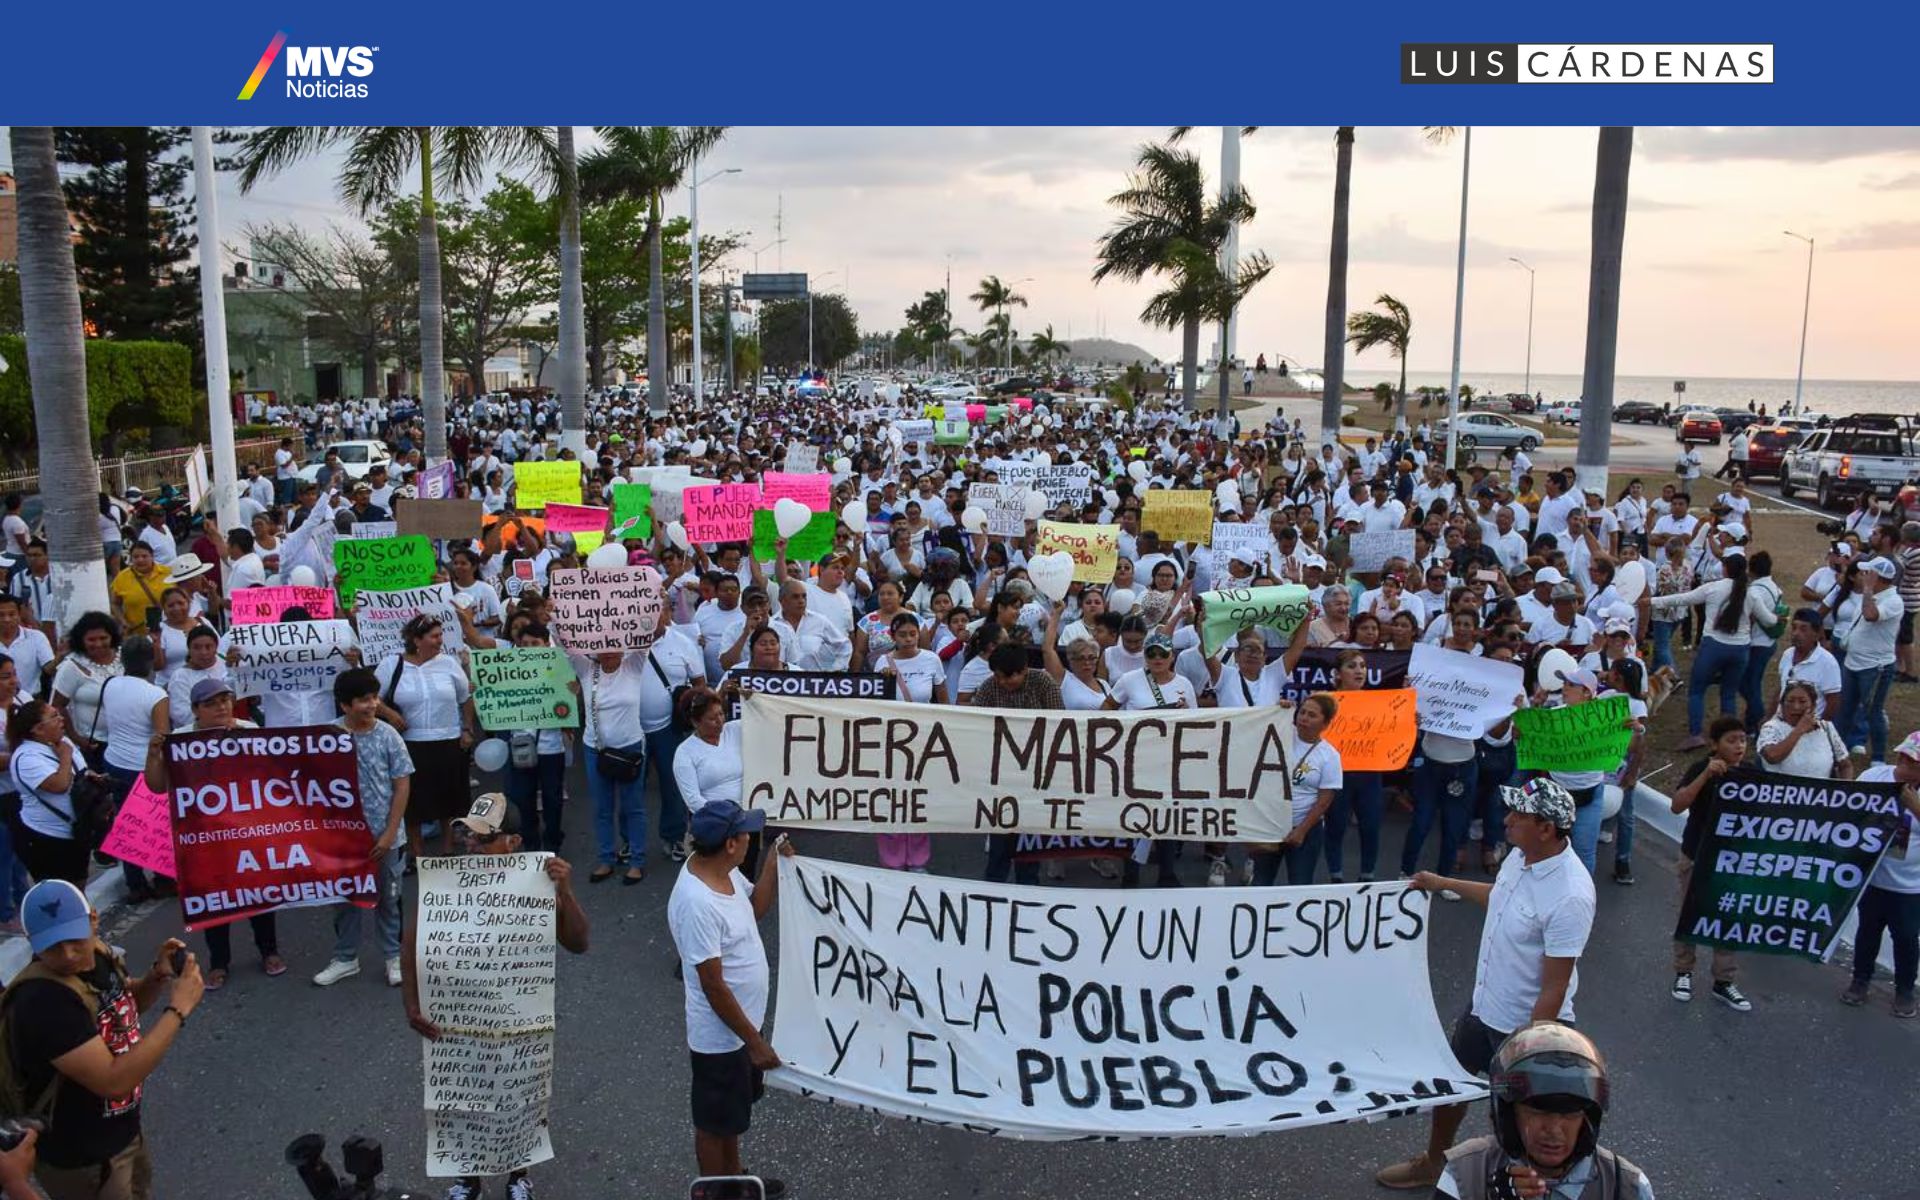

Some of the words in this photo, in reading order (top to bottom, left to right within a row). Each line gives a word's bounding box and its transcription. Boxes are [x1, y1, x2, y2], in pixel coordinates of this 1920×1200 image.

[552, 571, 576, 587] Los
[633, 567, 648, 582] si
[551, 588, 600, 600] tienen
[627, 601, 641, 615] ni
[643, 603, 661, 613] un
[230, 623, 322, 647] #FUERA
[235, 645, 346, 668] MARCELA
[281, 665, 337, 679] SOMOS
[859, 679, 885, 696] DE
[171, 735, 300, 762] NOSOTROS
[305, 733, 353, 754] LOS
[783, 713, 961, 784] FUERA
[990, 716, 1293, 800] MARCELA
[175, 769, 355, 819] POLICÍAS
[748, 781, 929, 824] CAMPECHE
[974, 795, 1020, 830] NO
[1043, 799, 1086, 831] TE
[1719, 781, 1900, 817] GOBERNADORA
[179, 833, 197, 846] NO
[197, 819, 302, 844] ENTREGAREMOS
[303, 819, 319, 831] EL
[322, 819, 366, 832] ESTADO
[1714, 812, 1884, 853] EXIGIMOS
[236, 849, 262, 874] A
[266, 843, 311, 870] LA
[420, 855, 528, 871] CAMPECHANOS
[1714, 849, 1864, 888] RESPETO
[456, 871, 507, 888] BASTA
[183, 873, 378, 916] DELINCUENCIA
[423, 891, 453, 907] QUE
[457, 893, 473, 907] LA
[426, 909, 469, 923] LAYDA
[474, 909, 549, 928] SANSORES
[795, 865, 874, 934] UN
[896, 885, 1080, 966] ANTES
[1136, 905, 1202, 964] UN
[1229, 884, 1430, 959] DESPÚES
[1717, 891, 1833, 927] #FUERA
[428, 930, 453, 942] NOS
[458, 932, 491, 944] ESTE
[497, 932, 544, 944] VIENDO
[425, 946, 441, 957] LA
[446, 945, 482, 958] CARA
[486, 945, 495, 957] Y
[498, 945, 530, 958] ELLA
[426, 958, 450, 971] QUE
[455, 960, 470, 971] ES
[427, 974, 441, 986] LA
[812, 935, 925, 1020] PARA
[935, 966, 1008, 1036] LA
[824, 1017, 860, 1078] Y
[906, 1030, 990, 1099] EL
